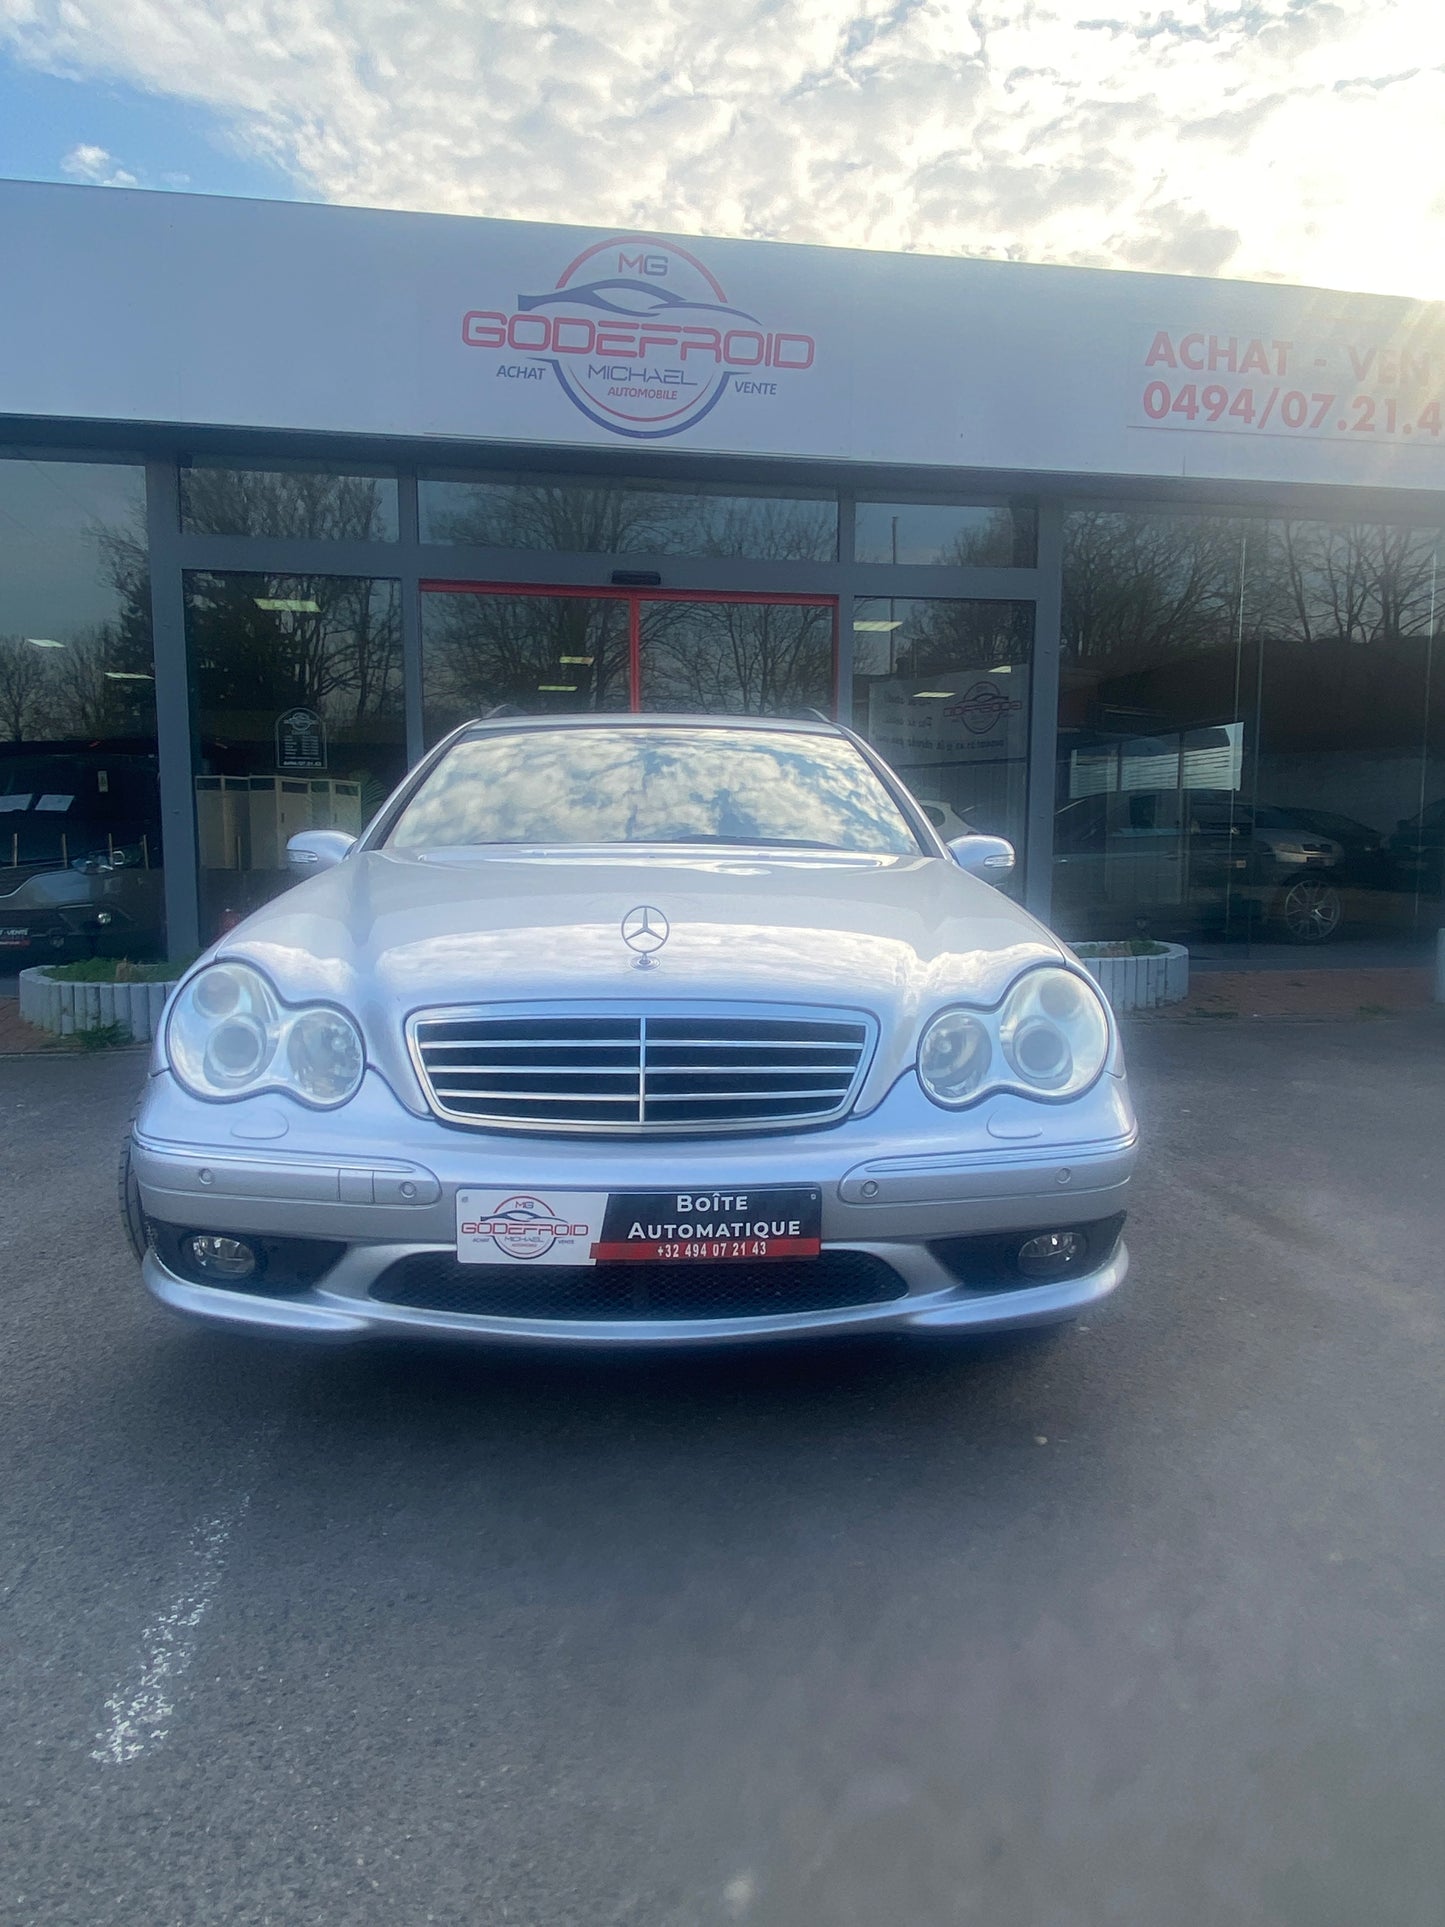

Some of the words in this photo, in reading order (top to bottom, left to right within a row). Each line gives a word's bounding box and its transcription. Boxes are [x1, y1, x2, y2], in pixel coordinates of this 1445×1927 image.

[618, 252, 668, 276] MG
[462, 310, 815, 369] GODEFROID
[1144, 331, 1294, 377] ACHAT
[496, 364, 546, 381] ACHAT
[588, 363, 698, 386] MICHAEL
[607, 386, 678, 400] AUTOMOBILE
[734, 381, 778, 396] VENTE
[1143, 380, 1443, 437] 0494/07.21.4
[514, 1201, 534, 1209] MG
[461, 1222, 589, 1236] GODEFROID
[657, 1244, 679, 1258] +32
[685, 1243, 707, 1257] 494
[712, 1242, 727, 1257] 07
[732, 1242, 746, 1256] 21
[752, 1241, 767, 1256] 43
